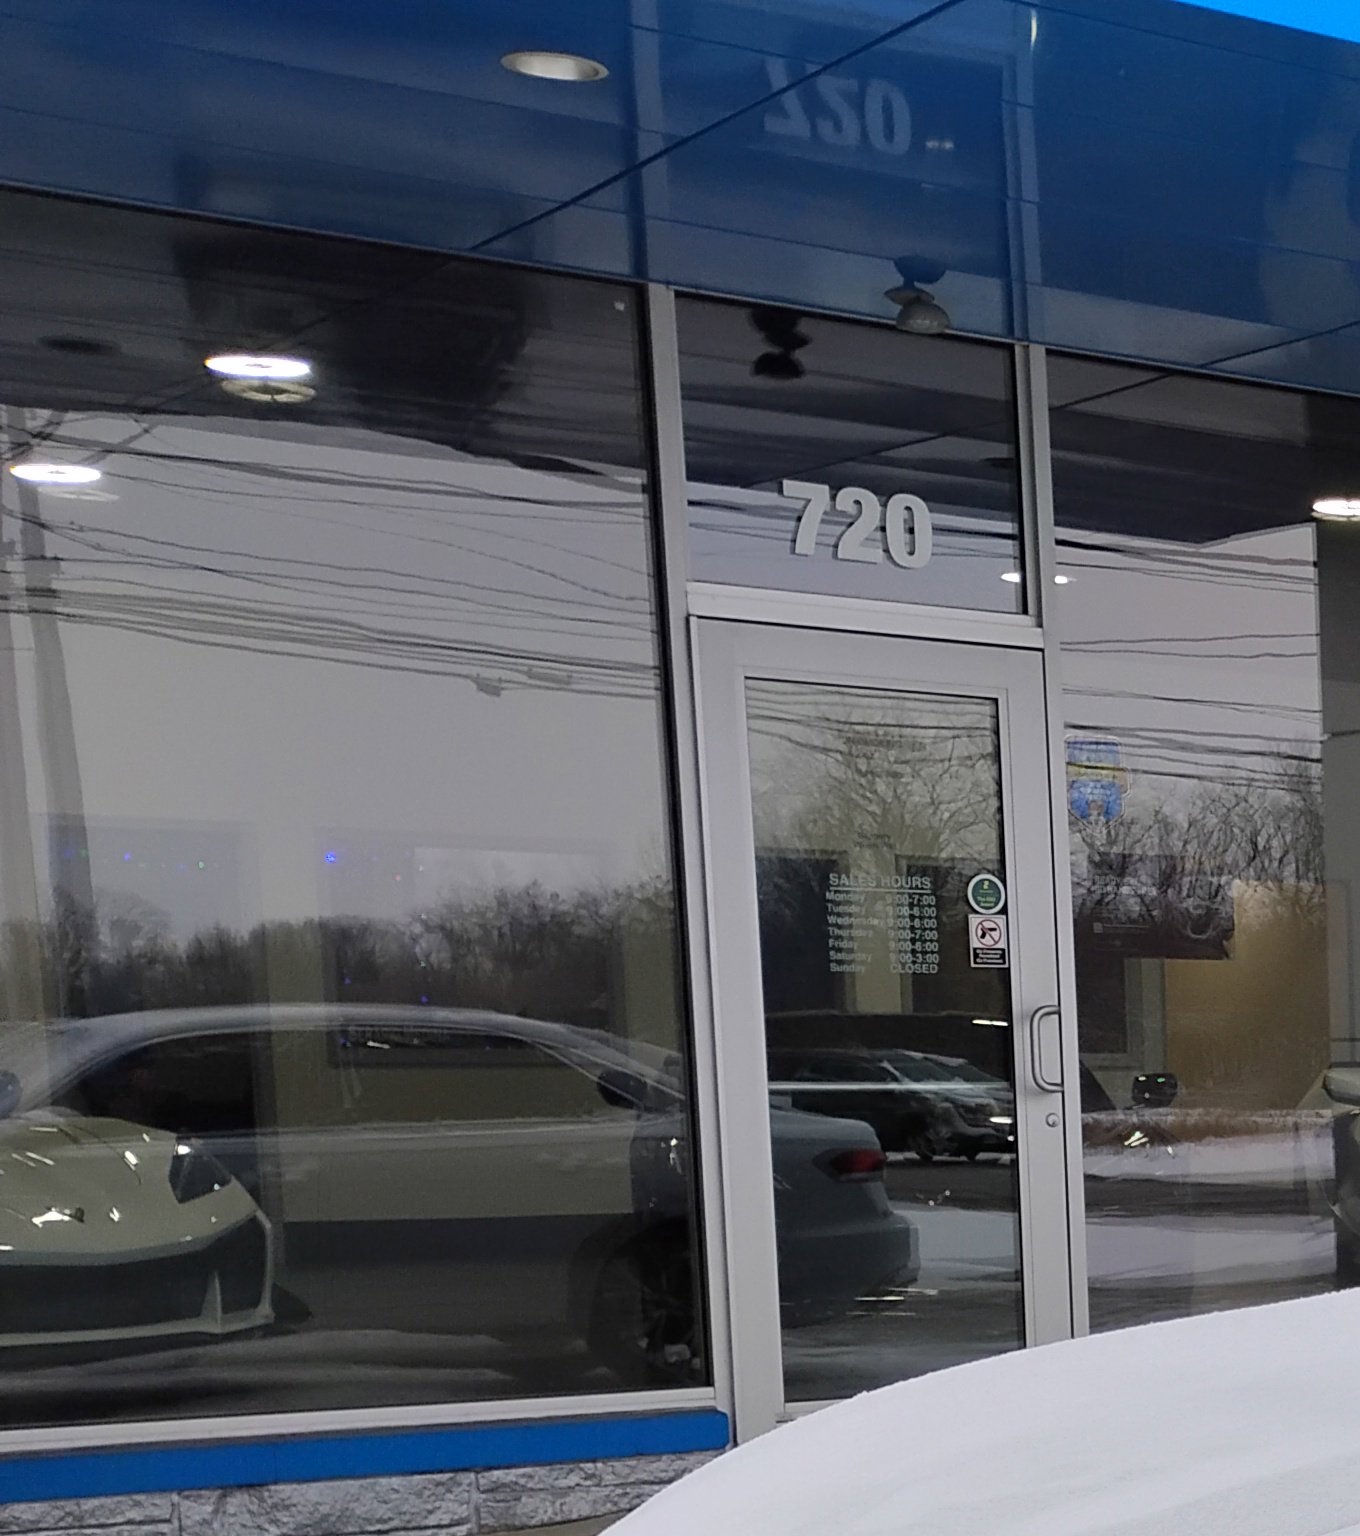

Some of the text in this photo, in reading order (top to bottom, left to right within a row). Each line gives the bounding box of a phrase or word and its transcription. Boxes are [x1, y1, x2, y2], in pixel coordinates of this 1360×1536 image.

[782, 479, 932, 569] 720
[829, 873, 931, 889] SALES HOURS
[825, 890, 866, 903] Monday
[828, 938, 858, 950] Friday
[829, 950, 873, 963] Saturday
[829, 962, 939, 975] Sunday CLOSED
